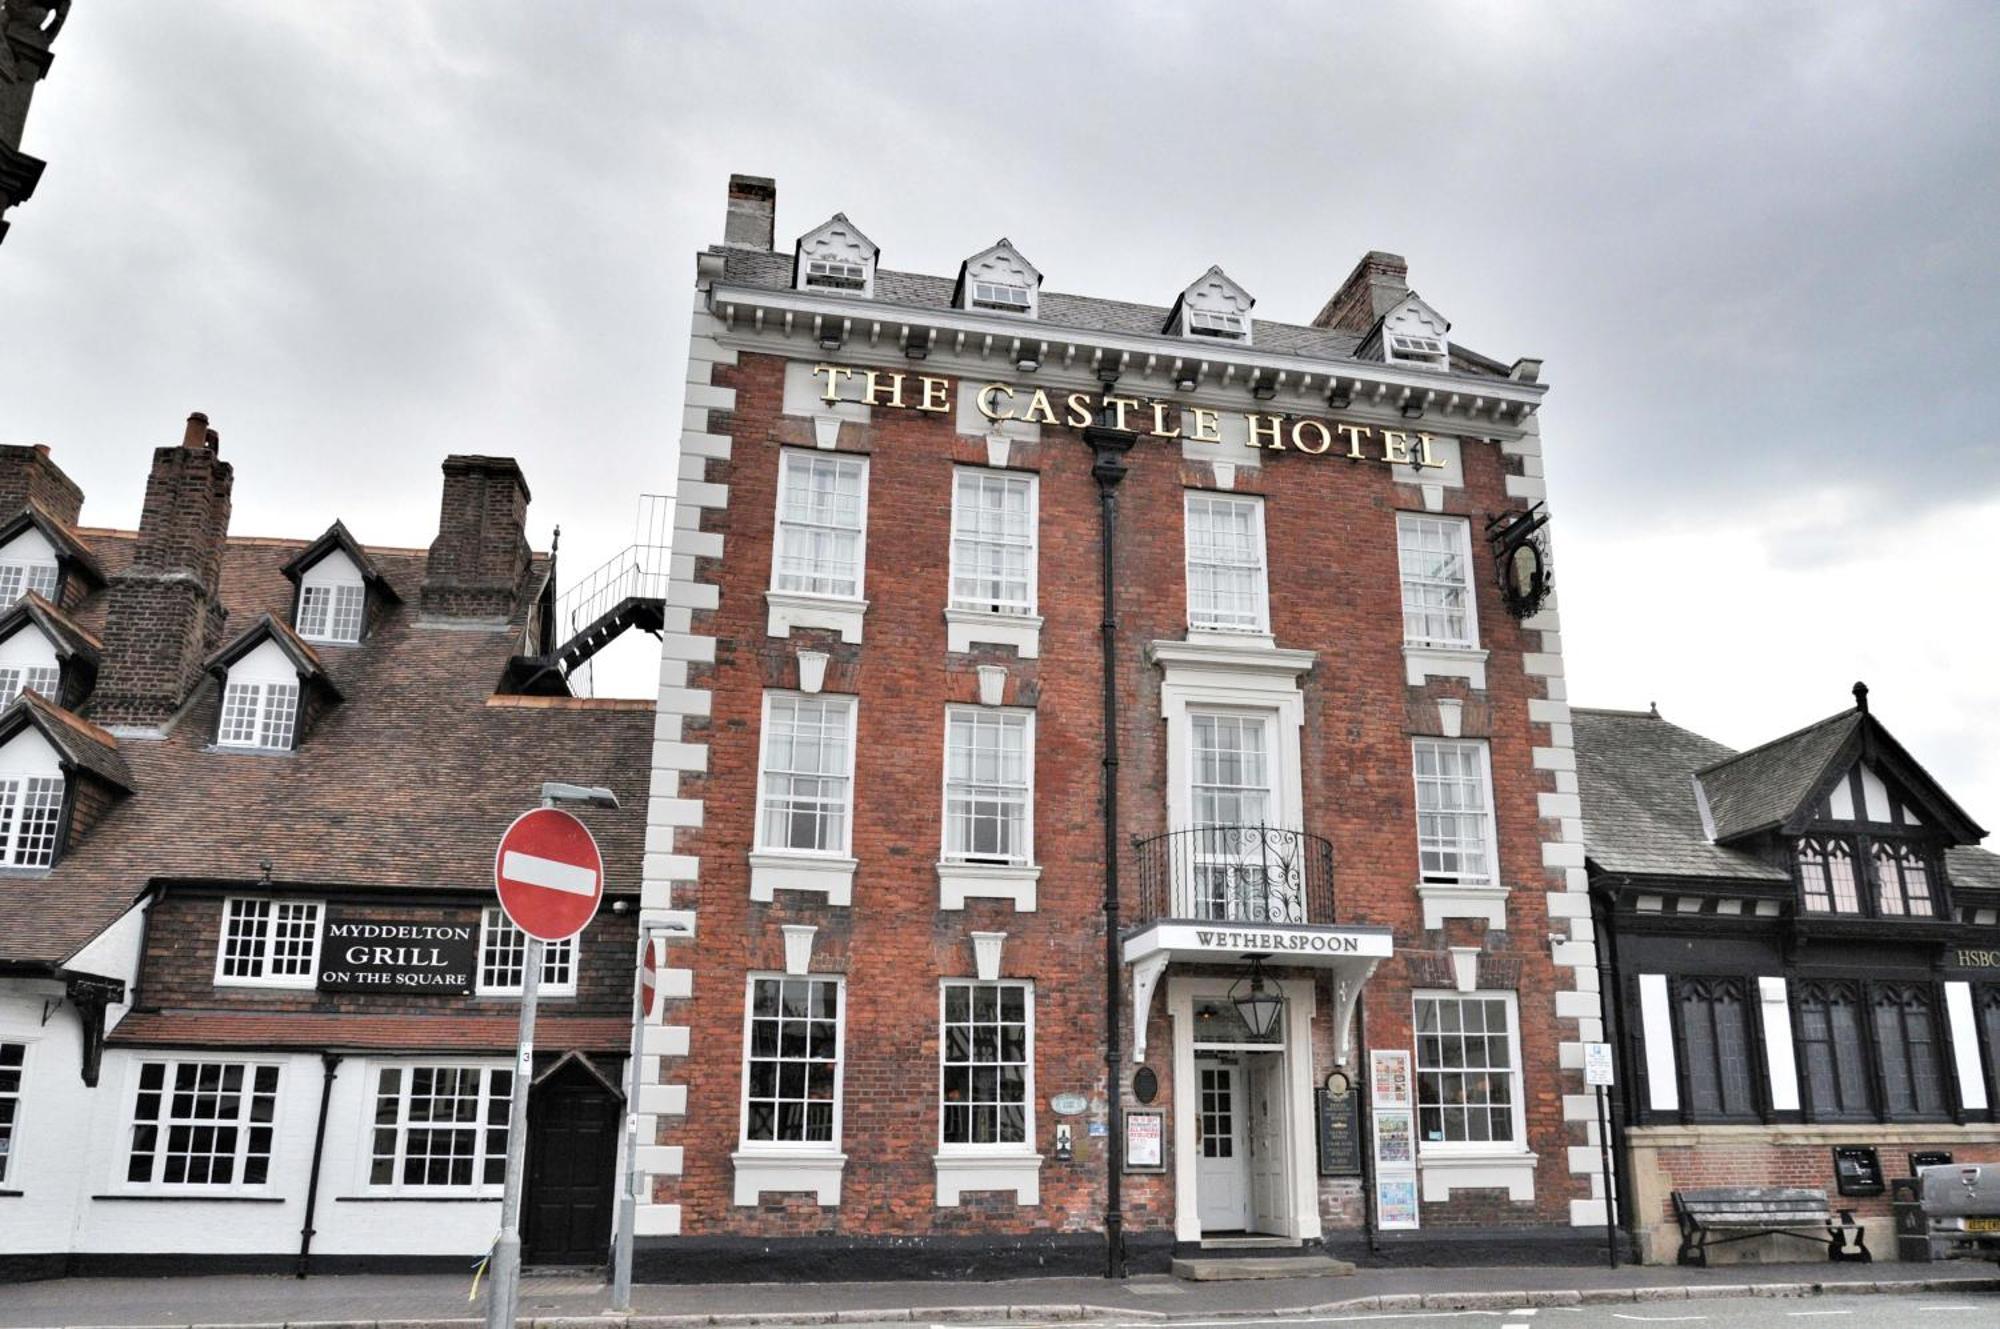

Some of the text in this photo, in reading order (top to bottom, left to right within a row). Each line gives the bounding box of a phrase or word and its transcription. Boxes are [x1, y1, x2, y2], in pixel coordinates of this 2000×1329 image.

[814, 364, 1447, 468] THE CASTLE HOTEL
[329, 924, 470, 940] MYDDELTON
[1196, 931, 1359, 952] WETHERSPOON
[345, 946, 449, 966] GRILL
[1957, 950, 2000, 968] HSBC
[322, 971, 467, 986] ON THE SQUARE
[523, 1052, 530, 1062] 3
